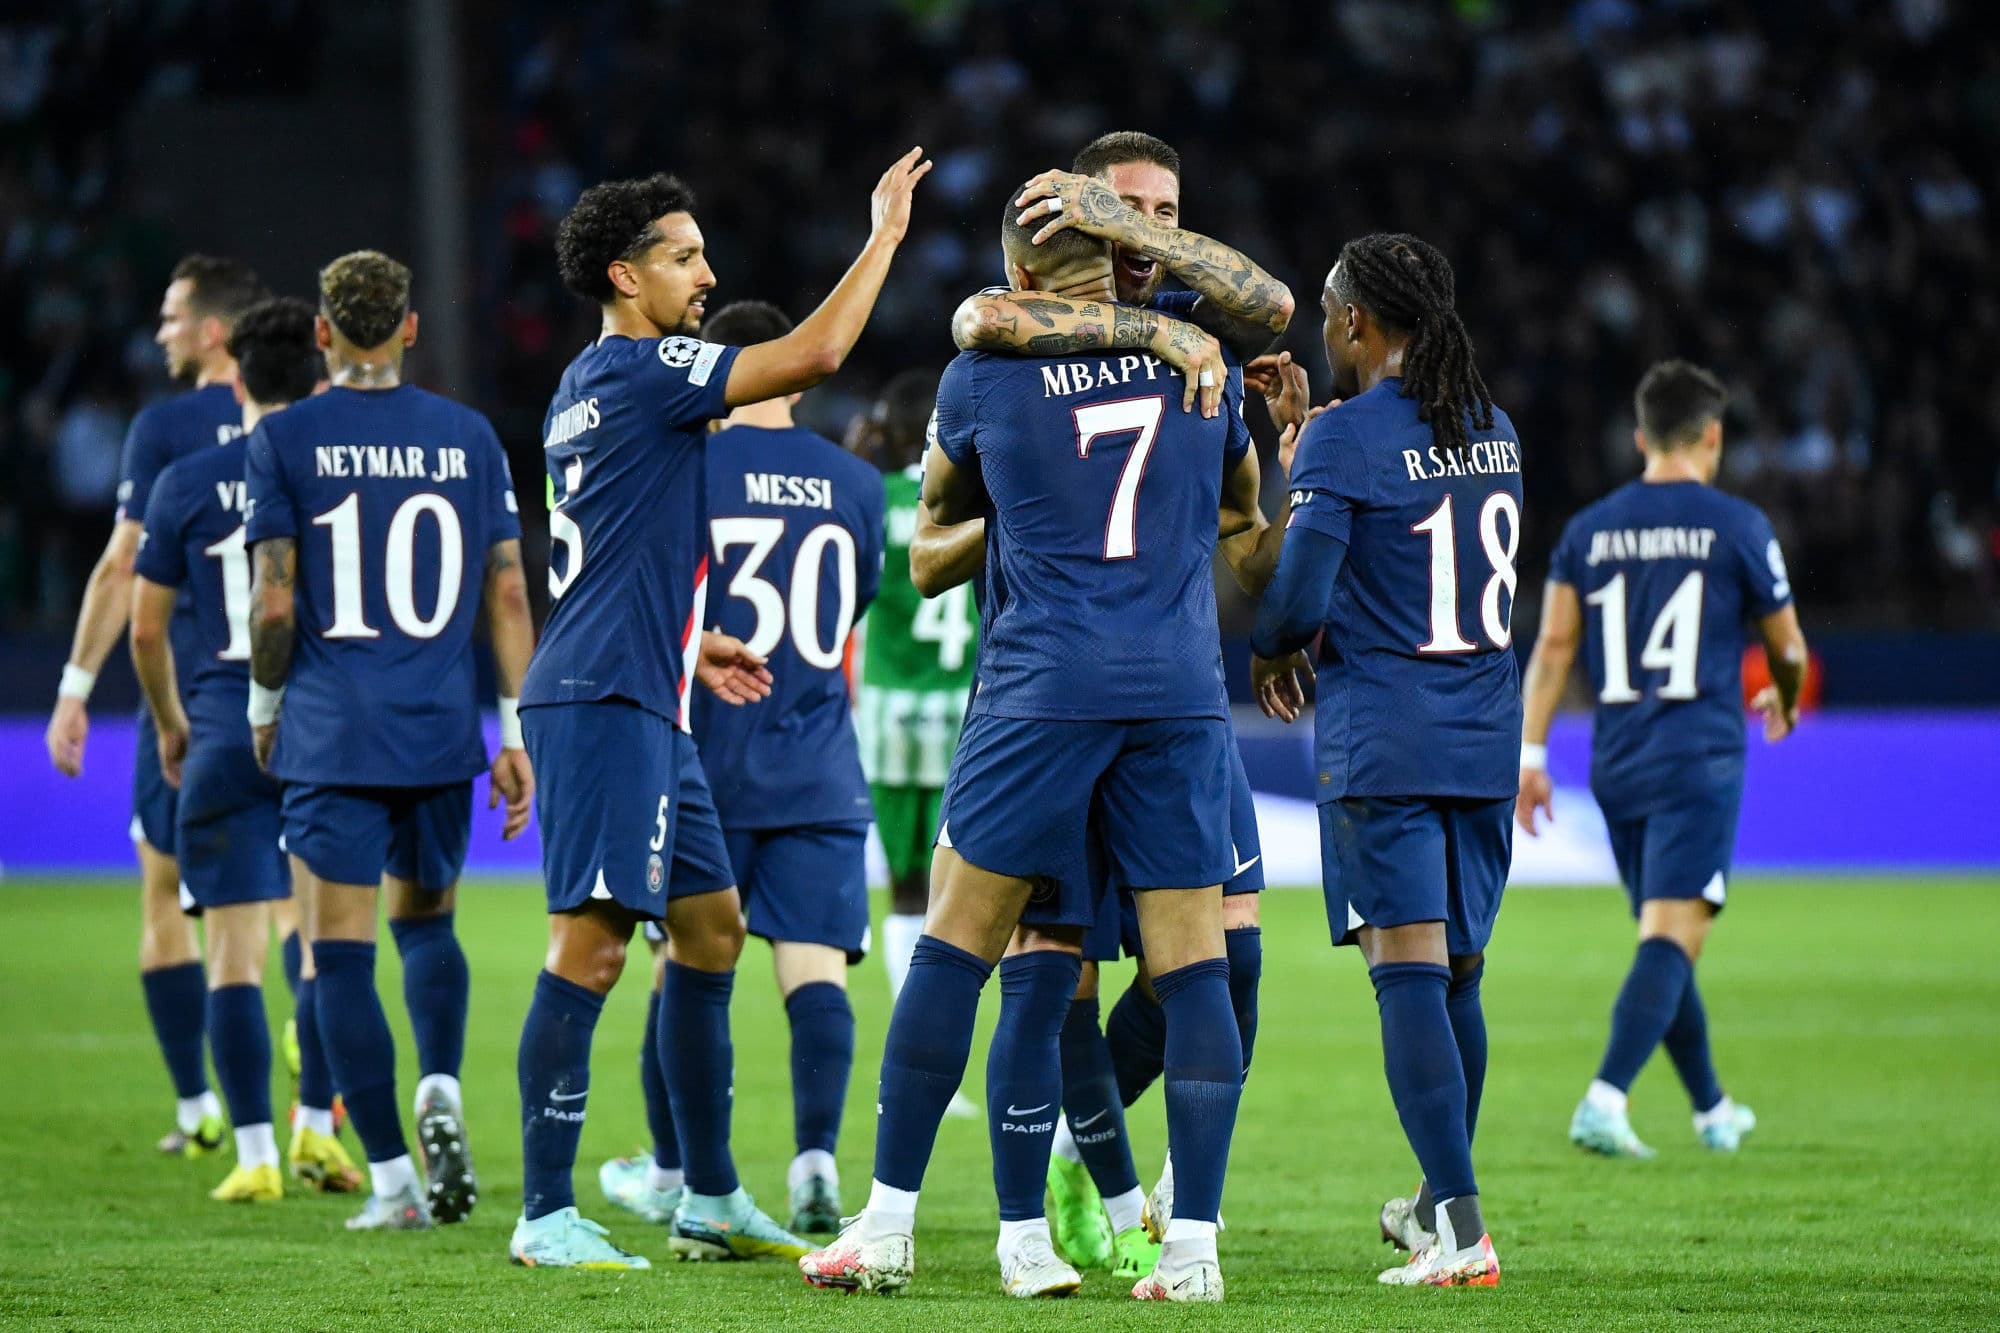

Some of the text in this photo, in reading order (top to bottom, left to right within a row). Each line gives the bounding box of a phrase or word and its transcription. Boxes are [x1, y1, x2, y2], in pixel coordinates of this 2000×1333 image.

[1040, 354, 1182, 398] MBAPP
[315, 446, 468, 483] NEYMAR JR
[744, 472, 833, 510] MESSI
[1071, 394, 1165, 561] 7
[311, 491, 464, 640] 10
[709, 516, 857, 671] 30
[1410, 490, 1520, 654] 18
[1585, 569, 1704, 704] 14
[649, 794, 669, 852] 5
[1001, 1121, 1053, 1134] PARIS
[1076, 1127, 1117, 1145] PARIS
